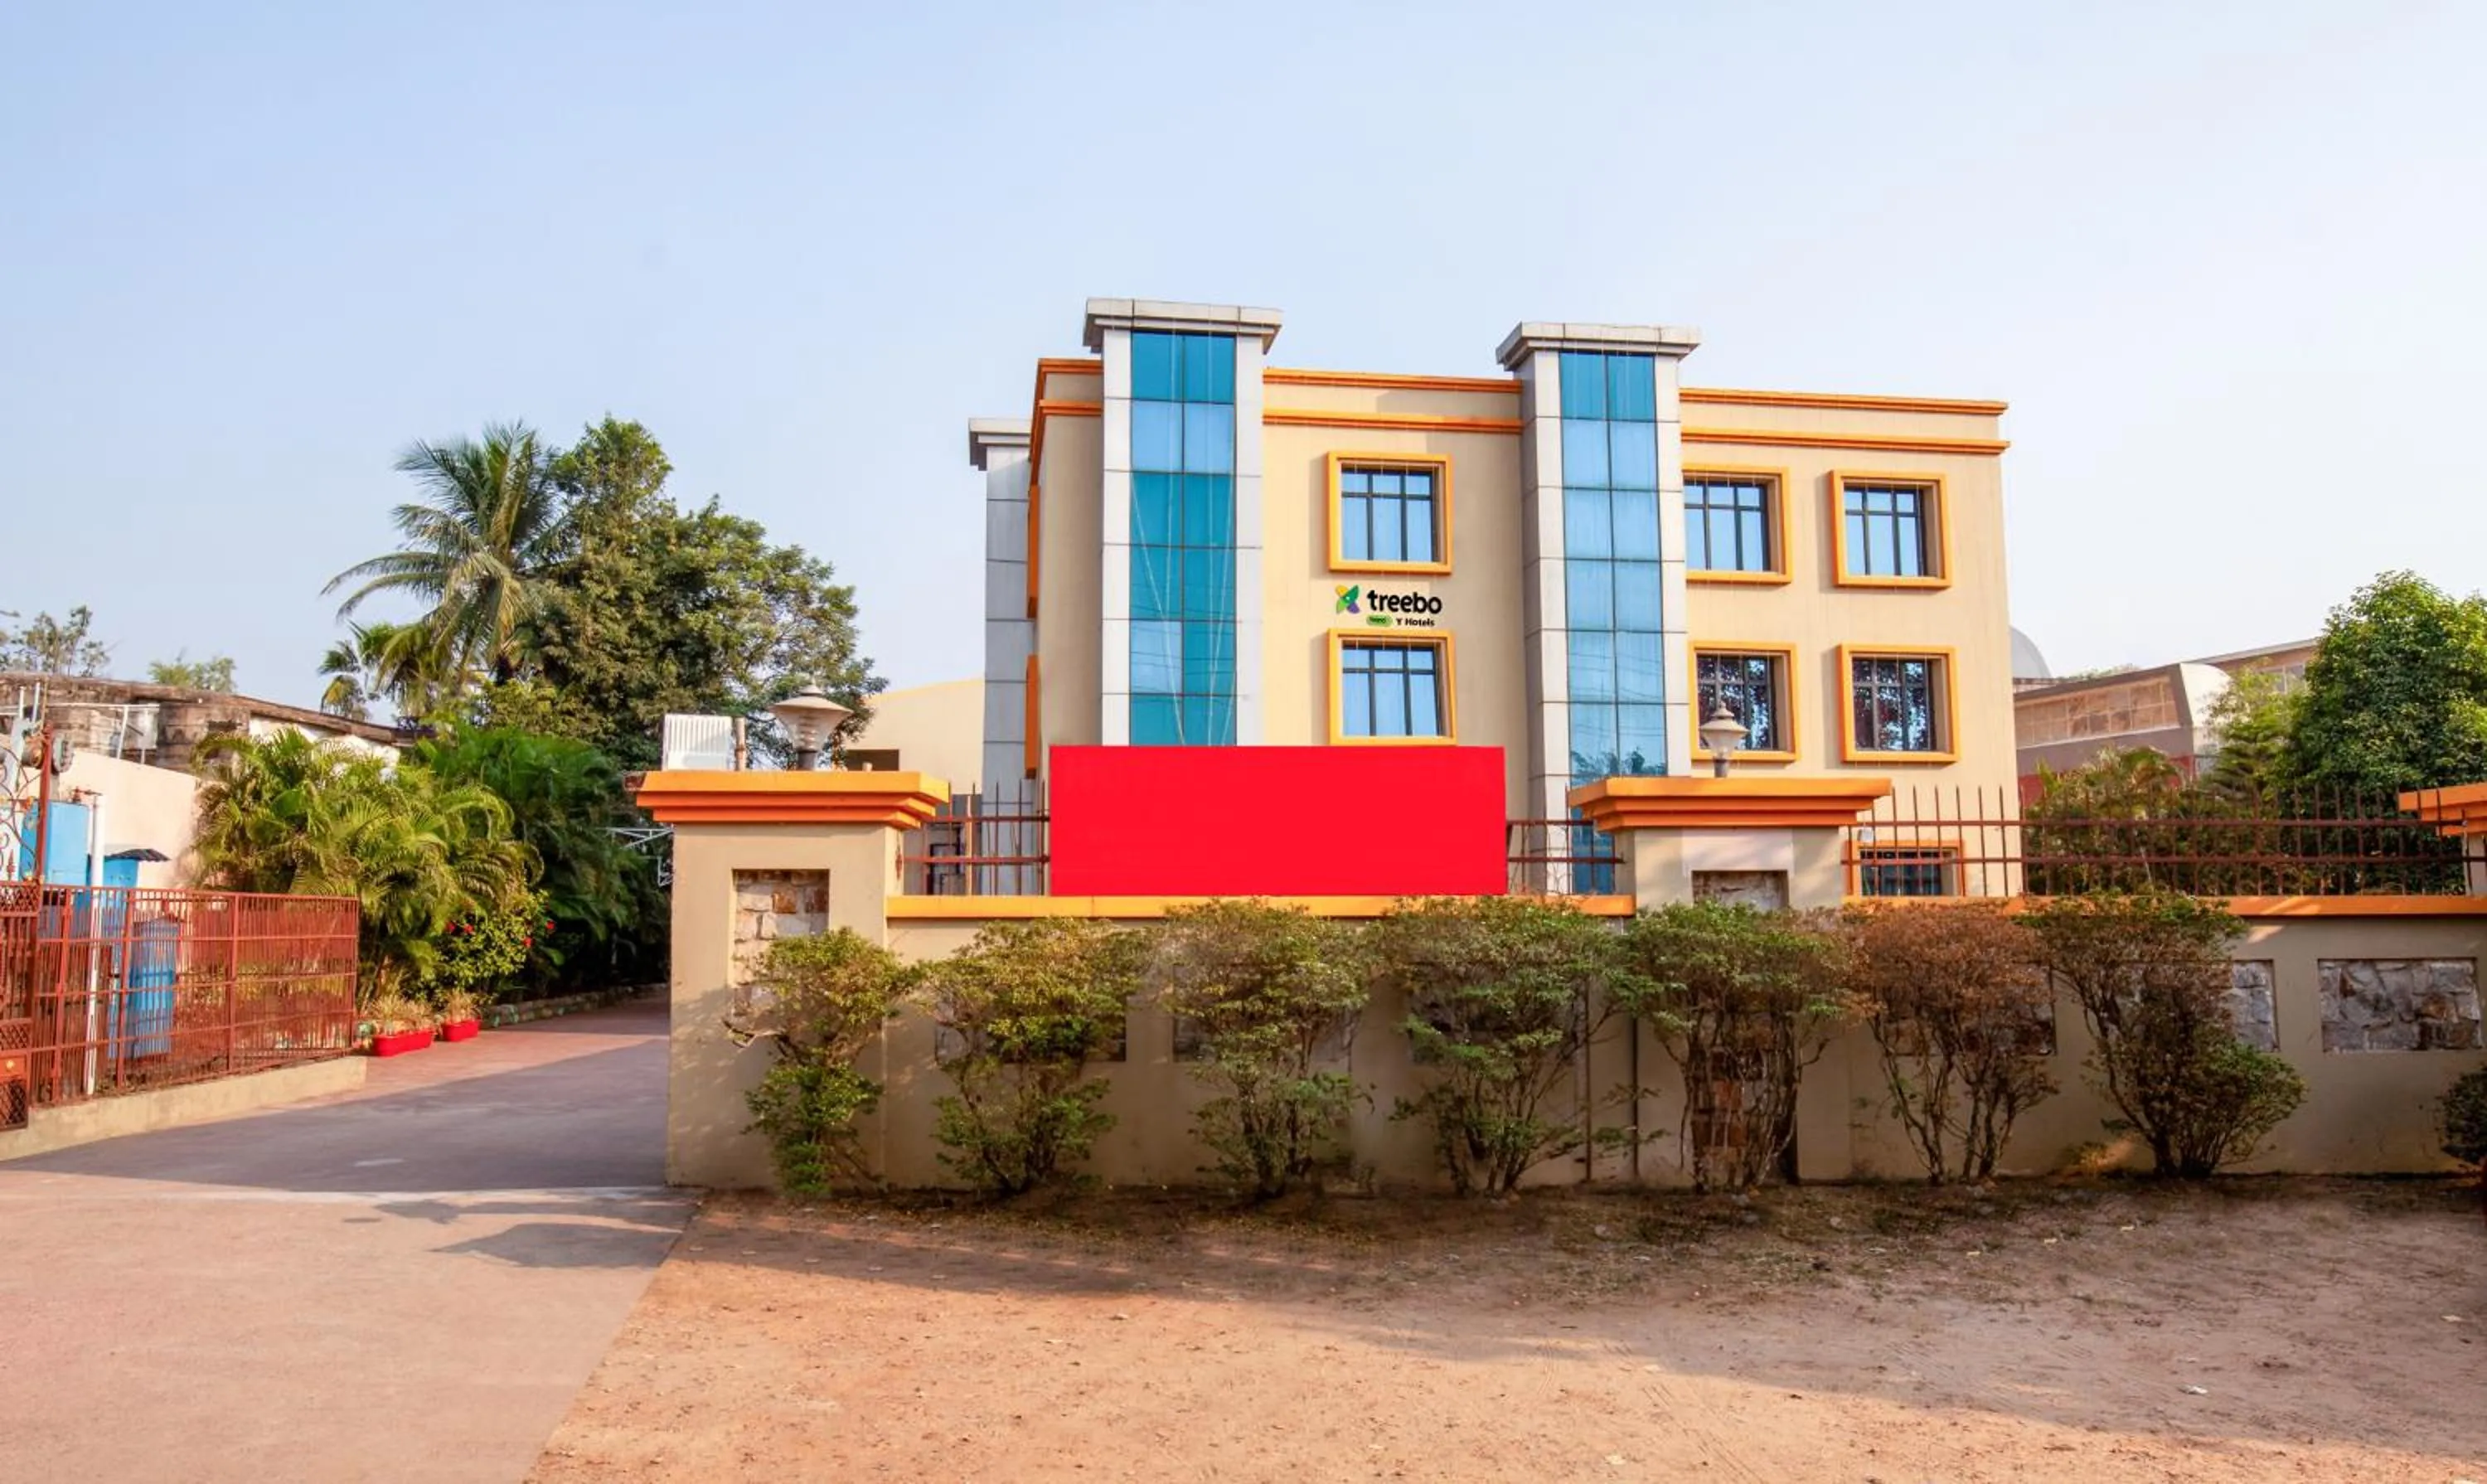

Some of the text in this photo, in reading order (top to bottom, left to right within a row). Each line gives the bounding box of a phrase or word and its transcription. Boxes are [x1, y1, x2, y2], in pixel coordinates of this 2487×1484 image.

[1367, 589, 1442, 614] treebo
[1396, 618, 1403, 626] Y
[1405, 618, 1435, 627] Hotels
